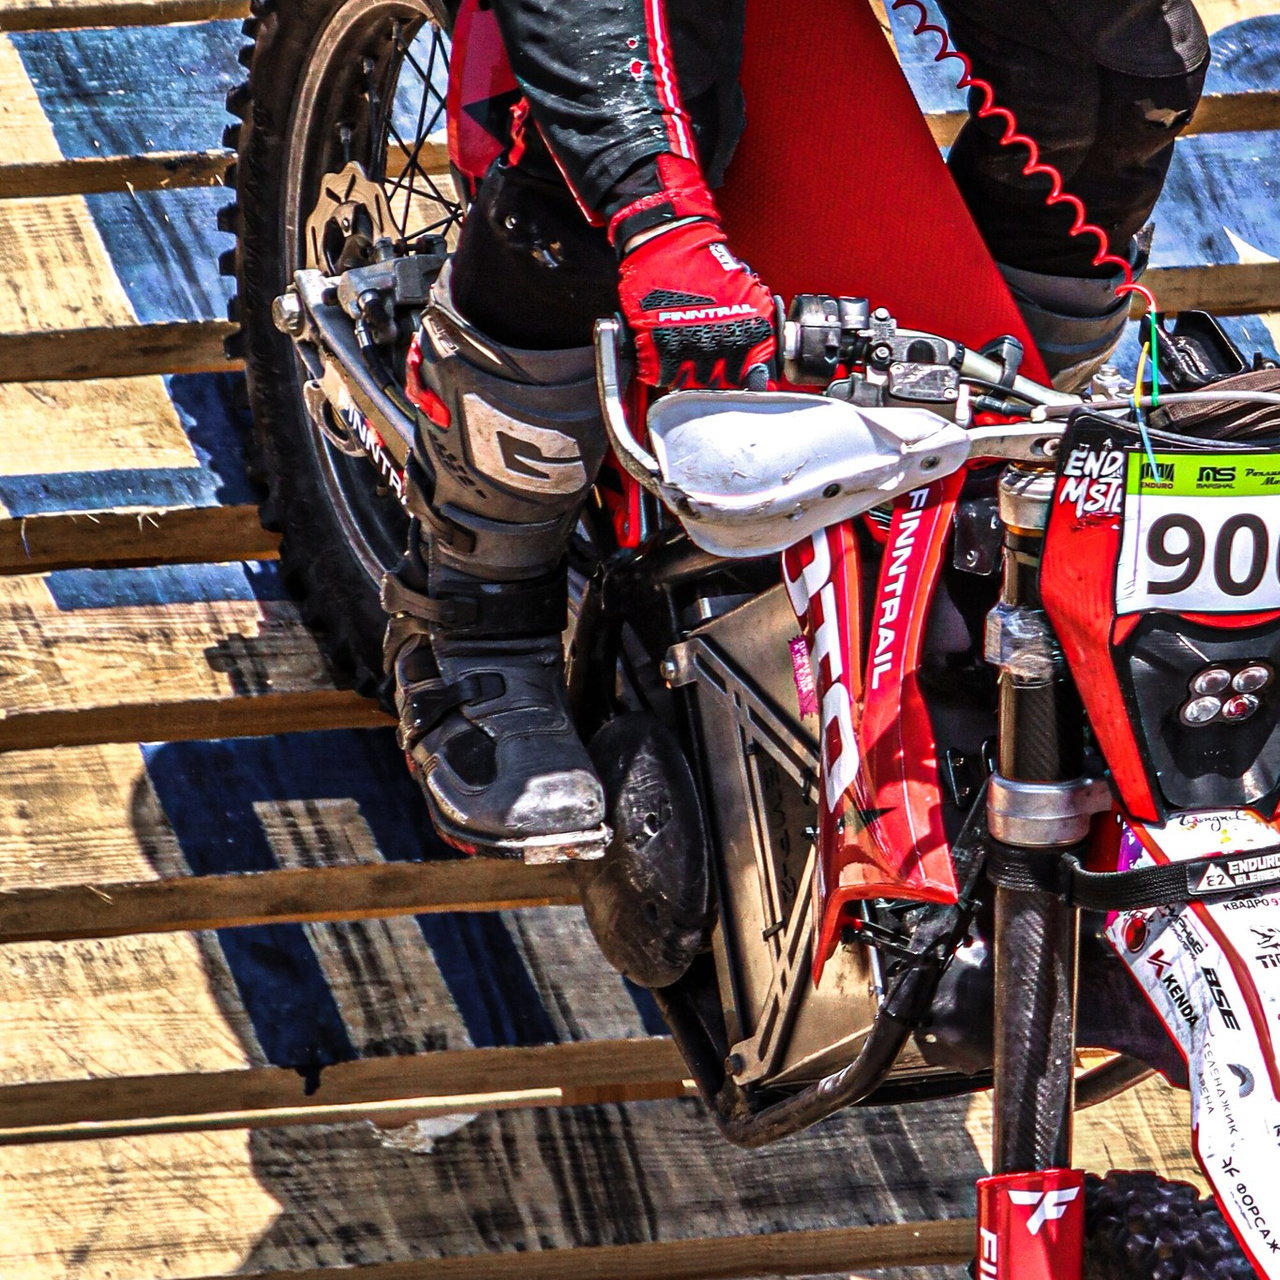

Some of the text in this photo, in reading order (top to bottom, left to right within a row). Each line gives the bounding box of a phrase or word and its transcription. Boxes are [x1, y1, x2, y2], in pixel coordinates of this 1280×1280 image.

[659, 304, 757, 322] FINNTRAIL
[871, 486, 928, 690] FINNTRAIL
[1222, 898, 1270, 912] КВАДРО
[1162, 973, 1200, 1028] KENDA
[1201, 966, 1241, 1031] BSE
